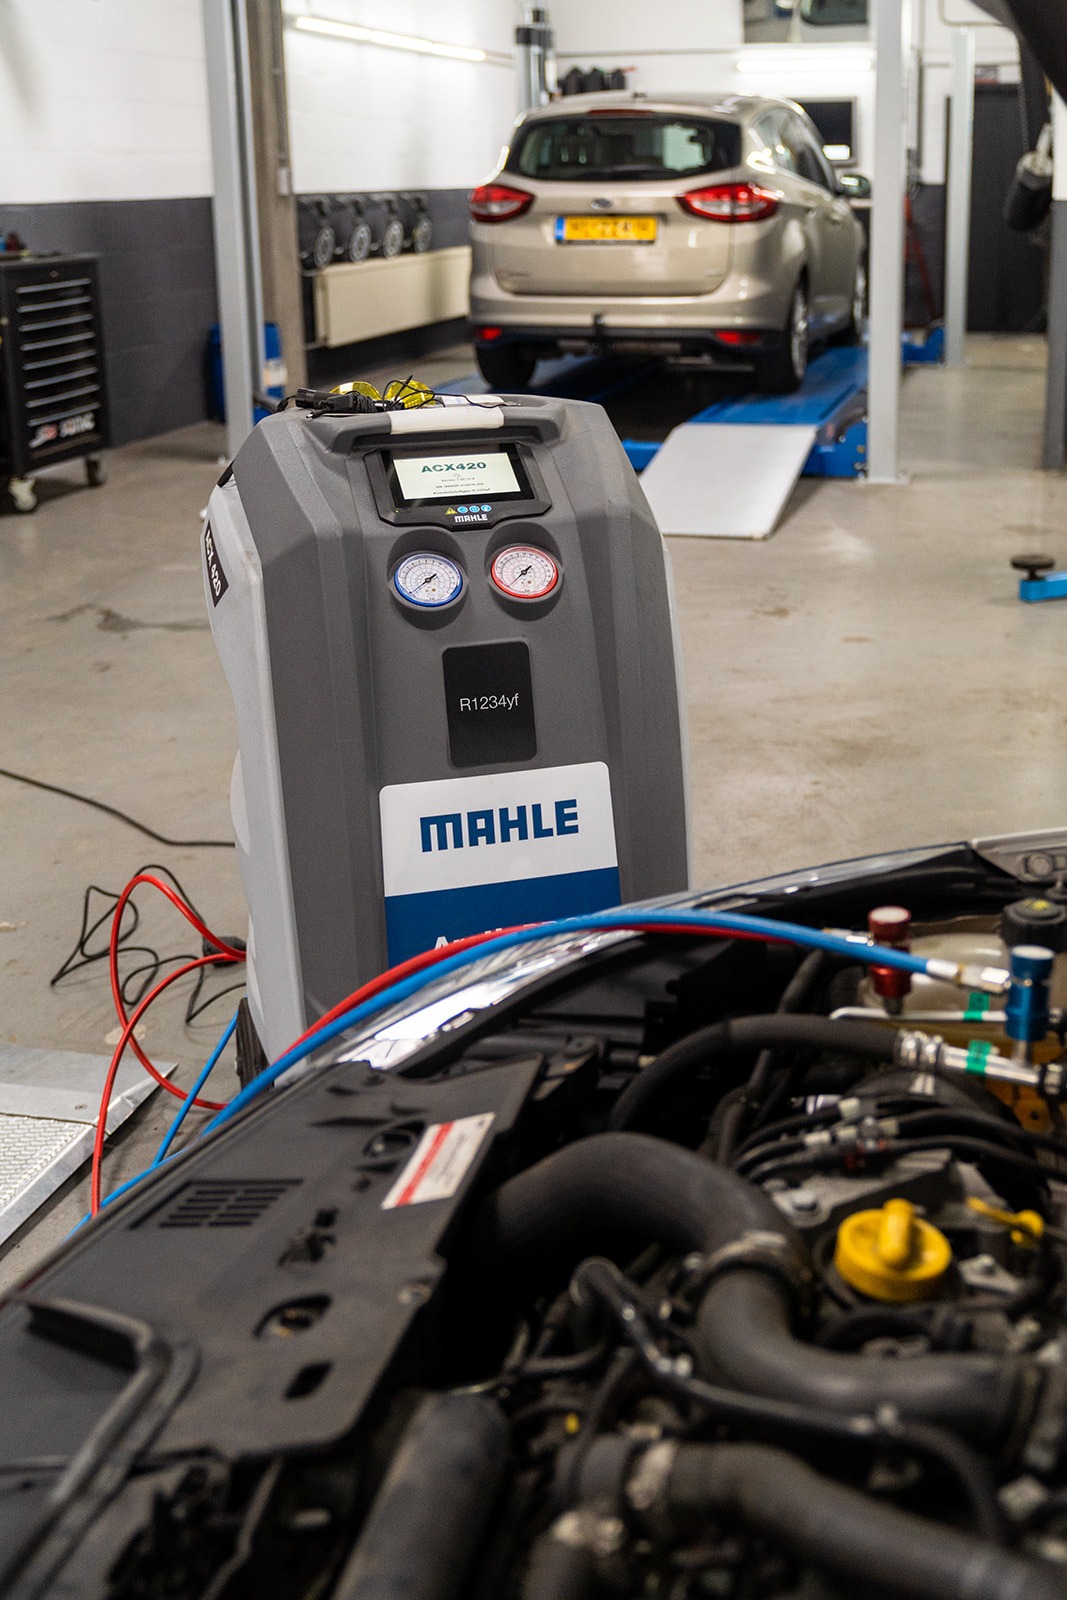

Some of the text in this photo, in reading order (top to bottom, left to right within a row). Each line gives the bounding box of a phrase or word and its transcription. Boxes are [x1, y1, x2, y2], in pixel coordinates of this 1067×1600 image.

[421, 461, 487, 473] ACX420
[454, 513, 488, 523] MAHLE
[211, 563, 221, 597] 420
[459, 692, 520, 712] R1234yf
[419, 798, 579, 853] MAHLE
